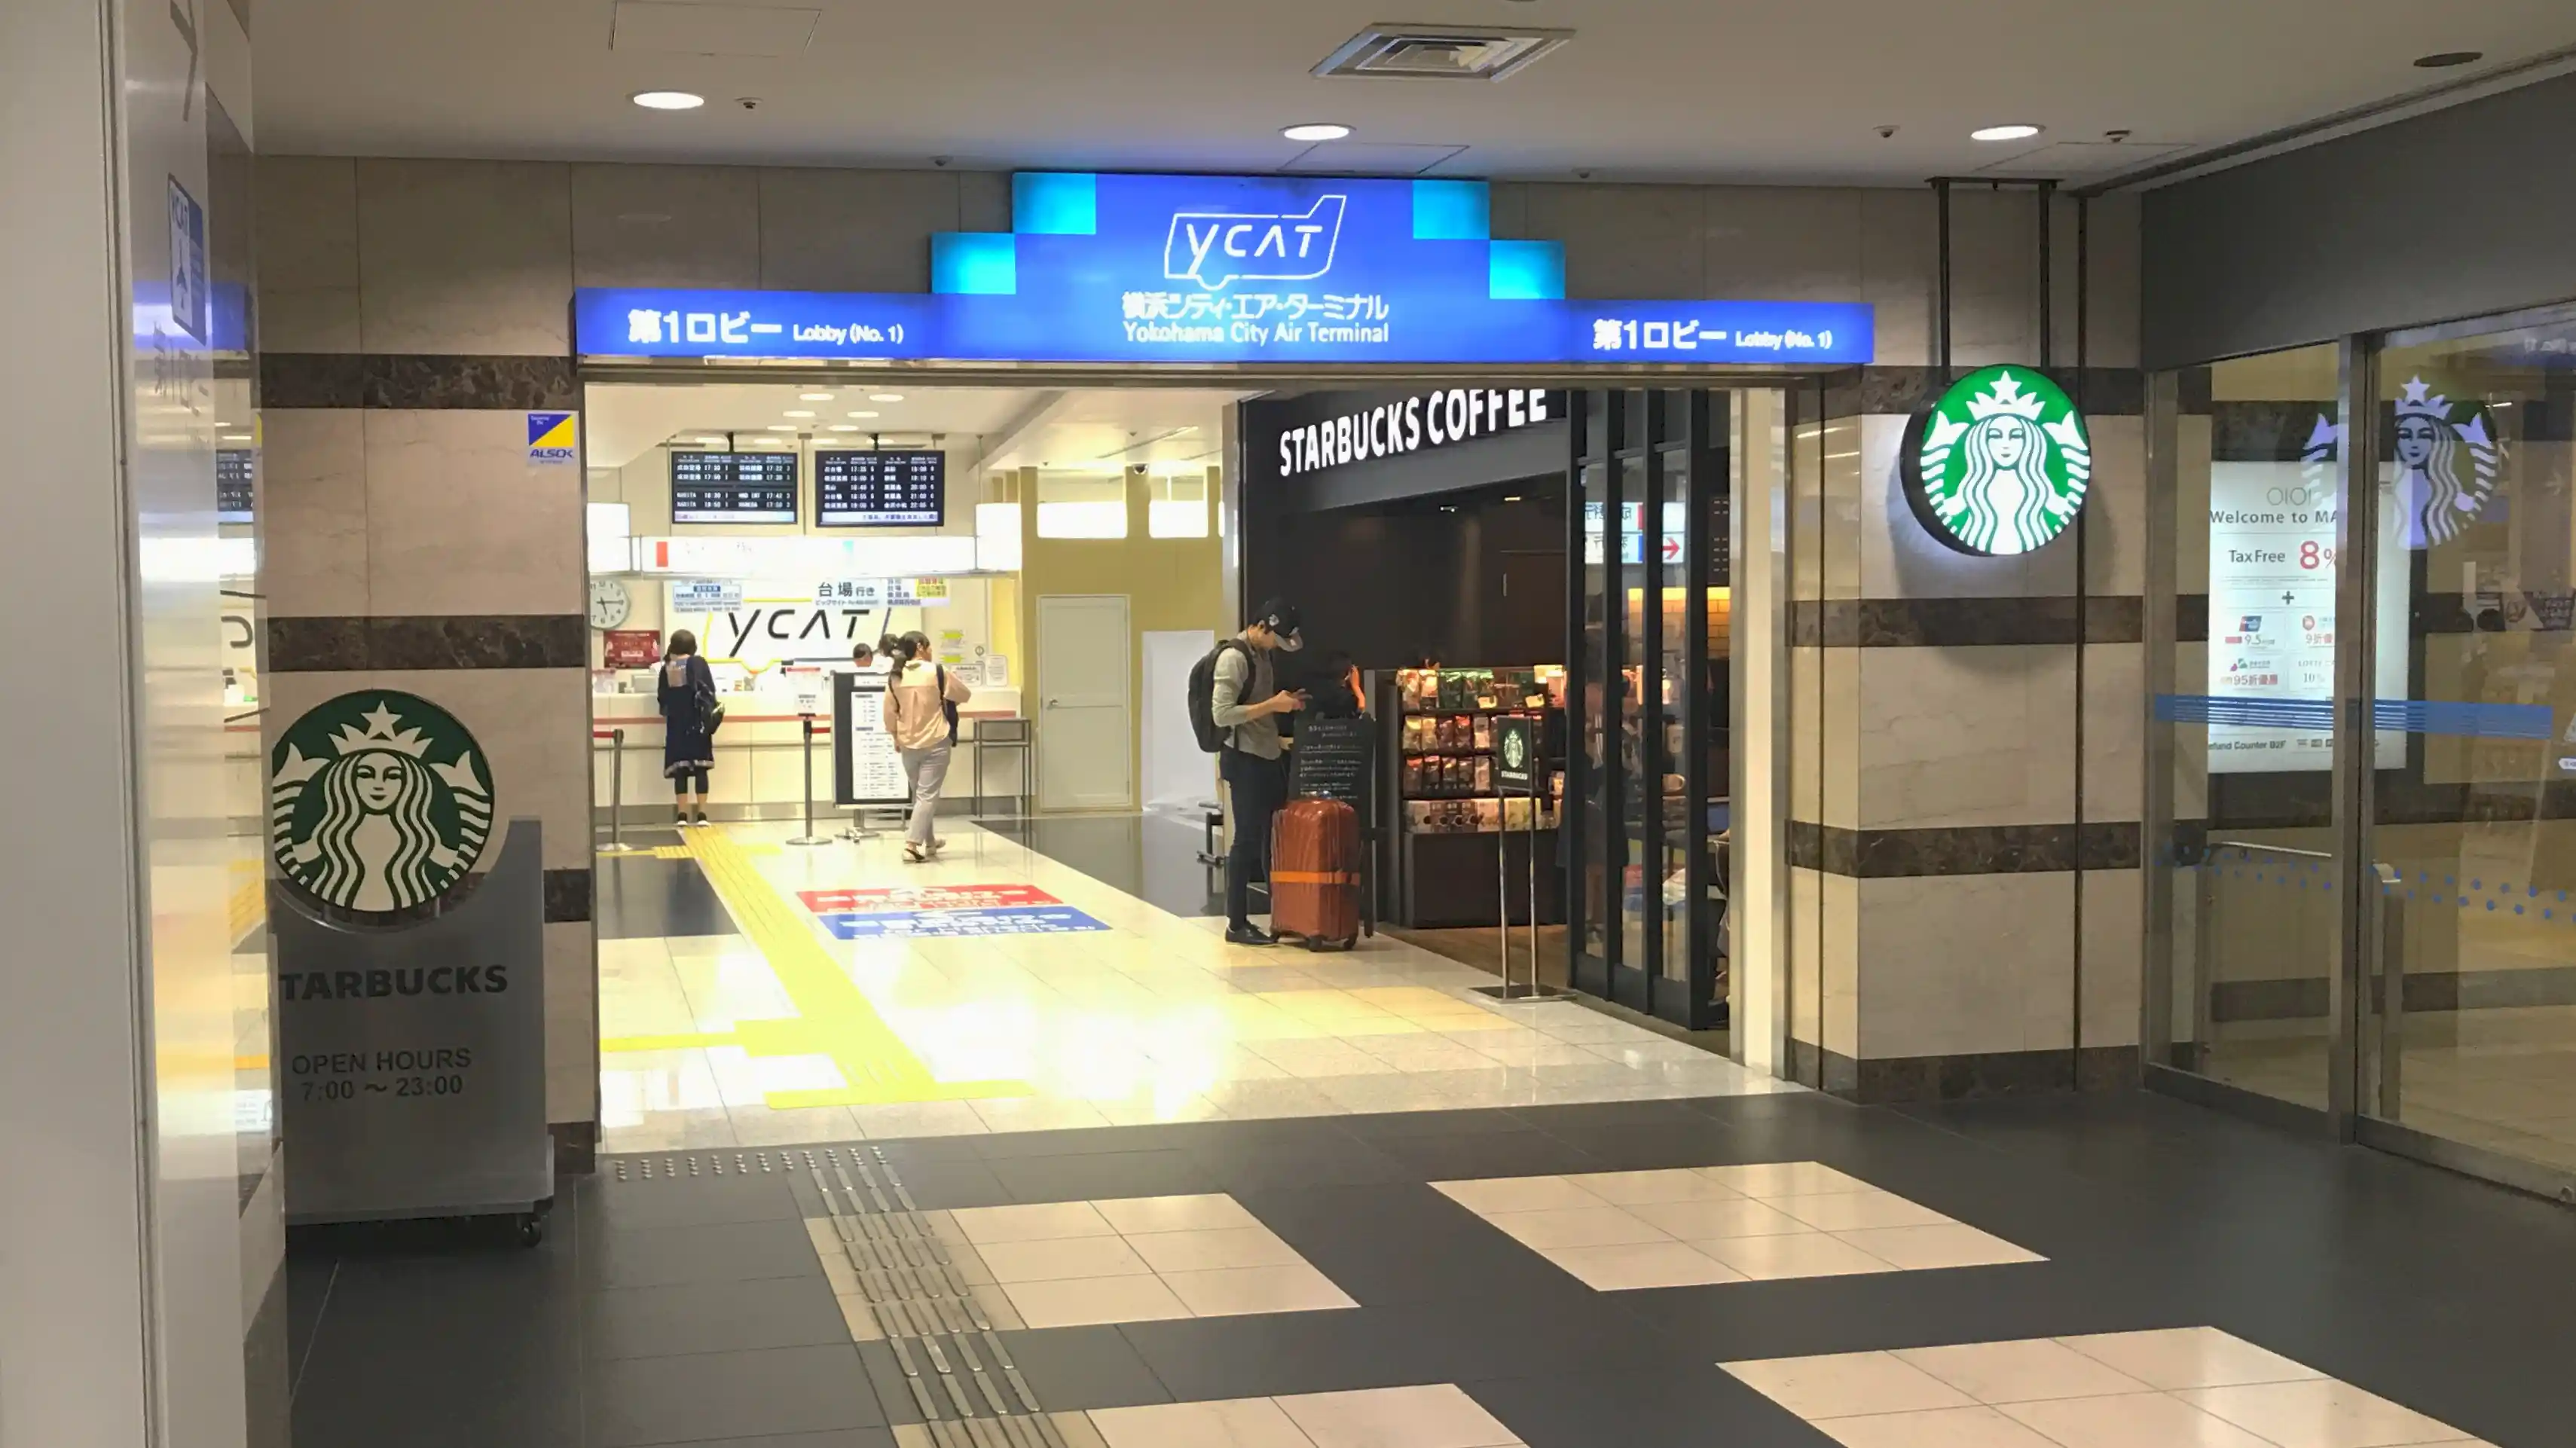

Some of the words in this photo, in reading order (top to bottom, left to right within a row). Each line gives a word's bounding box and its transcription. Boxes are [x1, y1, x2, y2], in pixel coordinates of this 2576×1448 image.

[628, 309, 782, 344] 第1ロビー
[793, 324, 846, 345] Lobby
[850, 324, 884, 344] (No.
[888, 324, 904, 344] 1)
[1123, 322, 1224, 343] Yokohama
[1230, 322, 1269, 347] City
[1274, 322, 1302, 343] Air
[1307, 322, 1389, 343] Terminal
[1593, 319, 1727, 350] 第1ロビー
[1735, 331, 1783, 350] Lobby
[1785, 330, 1815, 349] (No.
[1817, 330, 1832, 350] 1)
[1280, 397, 1420, 476] STARBUCKS
[1428, 389, 1546, 445] COFFEE
[530, 449, 574, 458] ALSOK
[2210, 510, 2285, 524] Welcome
[2292, 512, 2308, 524] to
[2228, 550, 2253, 563] Tax
[2255, 550, 2285, 563] Free
[2234, 740, 2267, 750] Counter
[2269, 740, 2286, 749] B2F
[279, 965, 508, 1000] TARBUCKS
[292, 1053, 365, 1074] OPEN
[377, 1048, 472, 1072] HOURS
[302, 1080, 354, 1101] 7:00
[396, 1076, 463, 1097] 23:00
